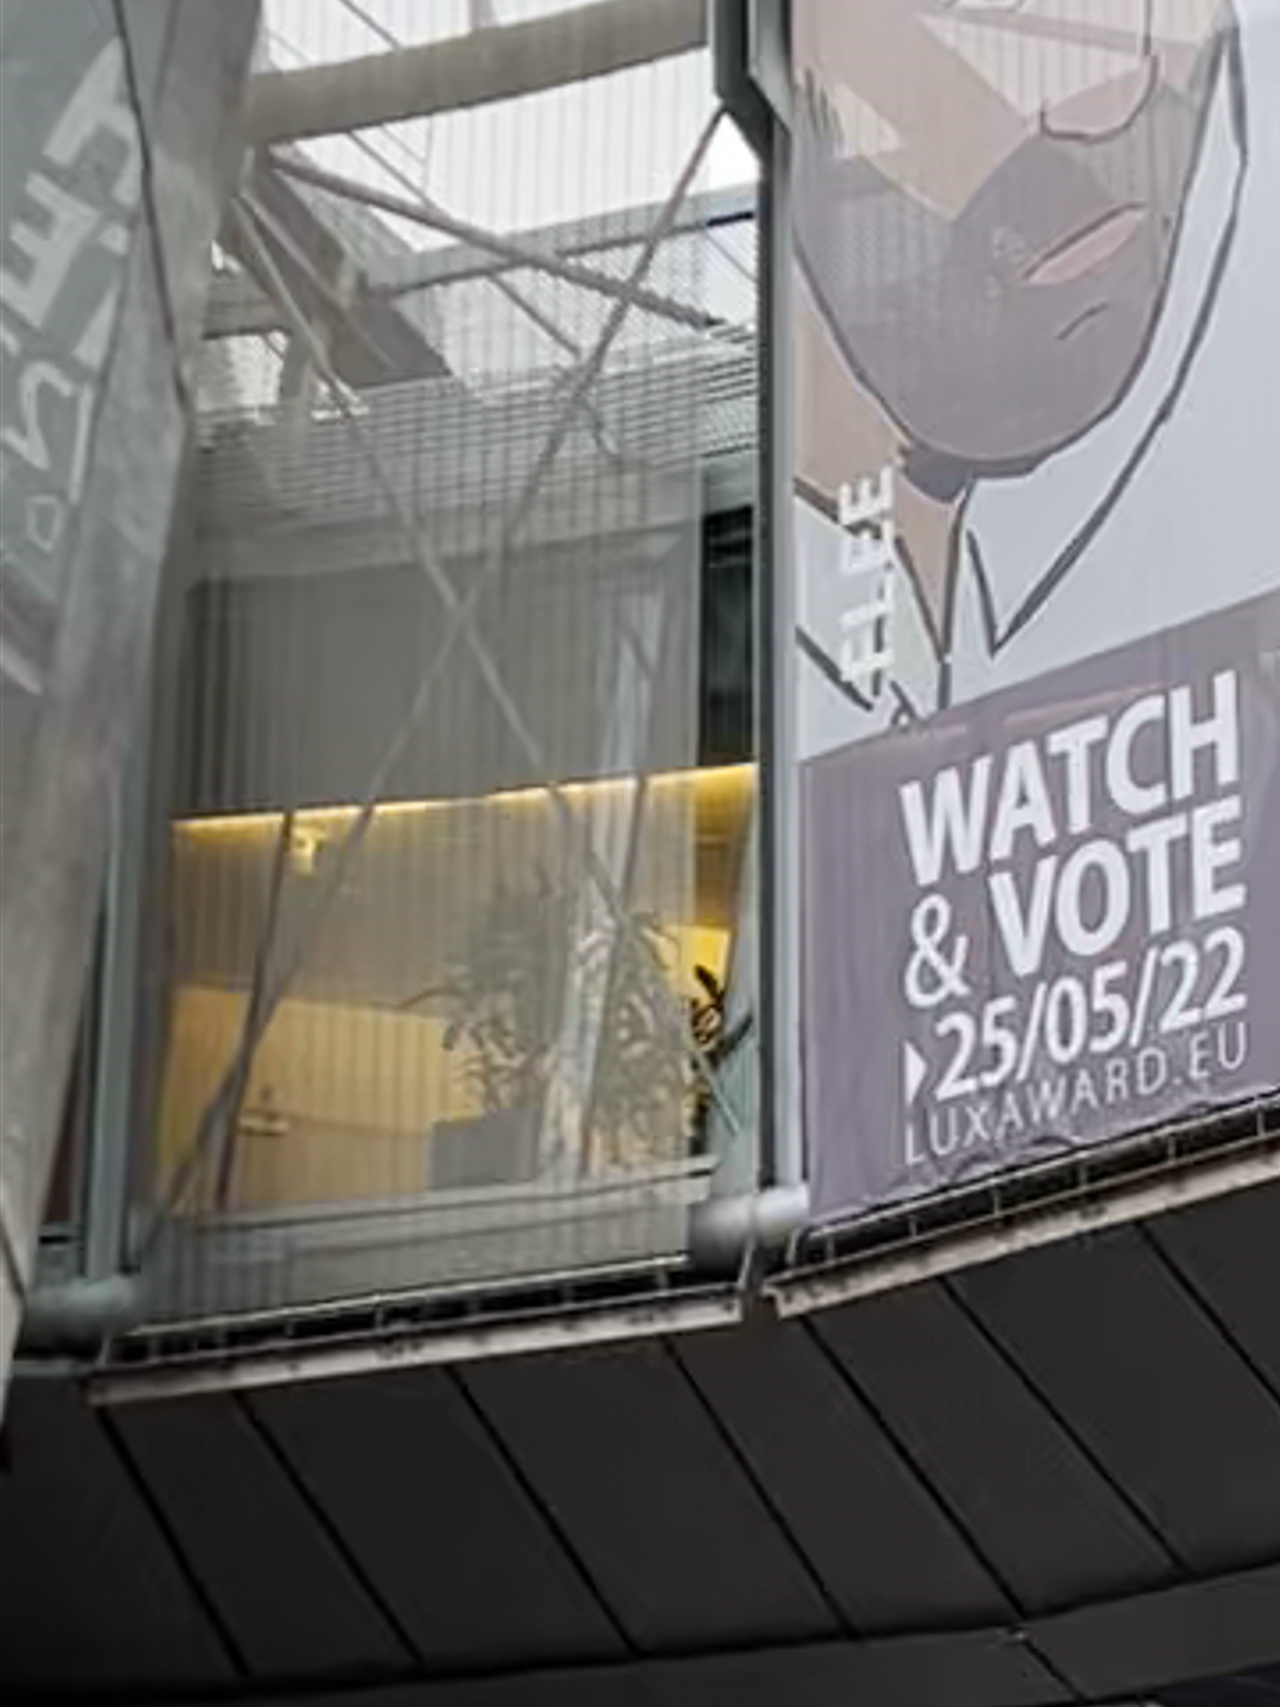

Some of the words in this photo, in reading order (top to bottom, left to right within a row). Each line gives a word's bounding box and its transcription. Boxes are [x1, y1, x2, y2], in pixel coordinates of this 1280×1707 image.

[900, 670, 1239, 887] WATCH
[904, 893, 972, 1009] &
[988, 794, 1247, 978] VOTE
[905, 1020, 1250, 1167] LUXAWARD.EU
[933, 925, 1249, 1102] 25/05/22
